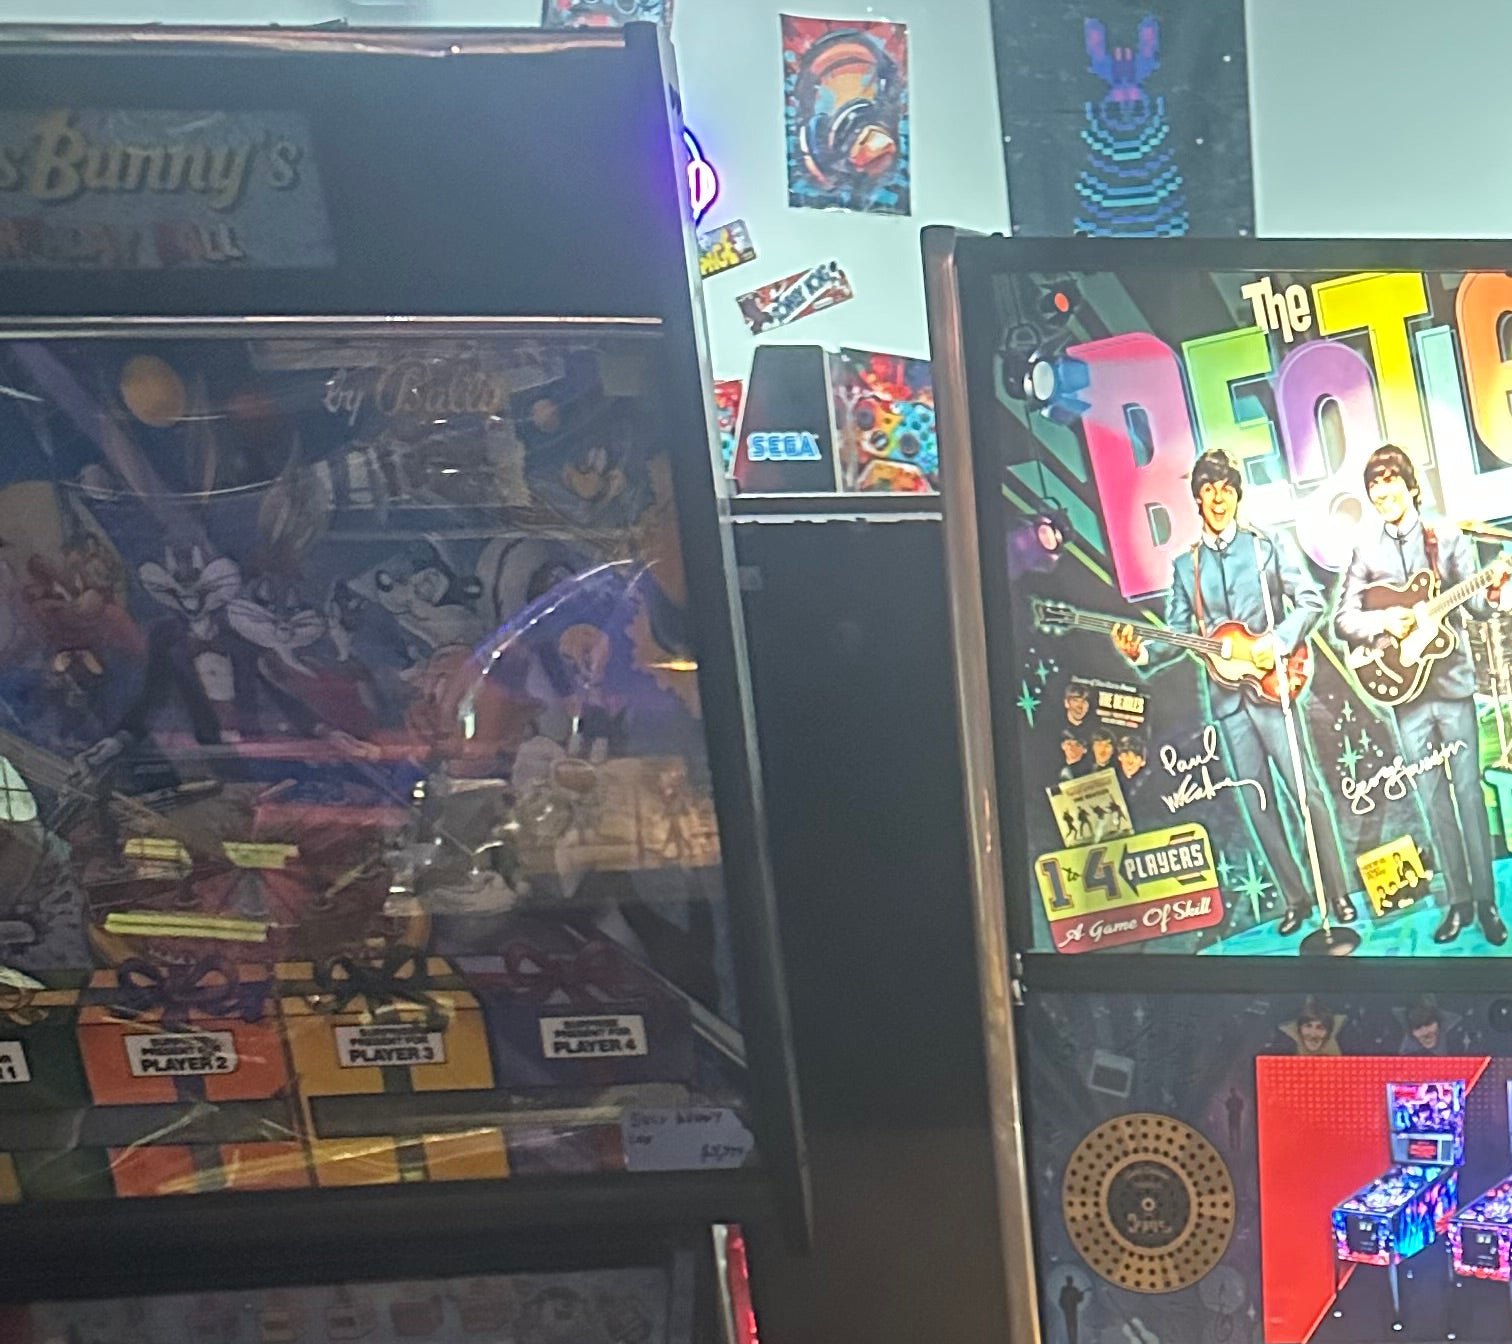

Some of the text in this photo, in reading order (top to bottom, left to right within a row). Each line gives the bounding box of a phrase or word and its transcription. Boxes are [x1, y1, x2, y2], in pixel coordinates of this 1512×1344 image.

[30, 110, 300, 212] Bunny's
[1242, 276, 1312, 344] The
[751, 435, 820, 458] SEGA
[1040, 842, 1206, 912] 1 to 4 PLAYERS
[1058, 895, 1213, 950] A Game Of Skill
[141, 1057, 229, 1073] PLAYER 2
[351, 1048, 434, 1063] PLAYER 3
[553, 1040, 638, 1054] PLAYER 4
